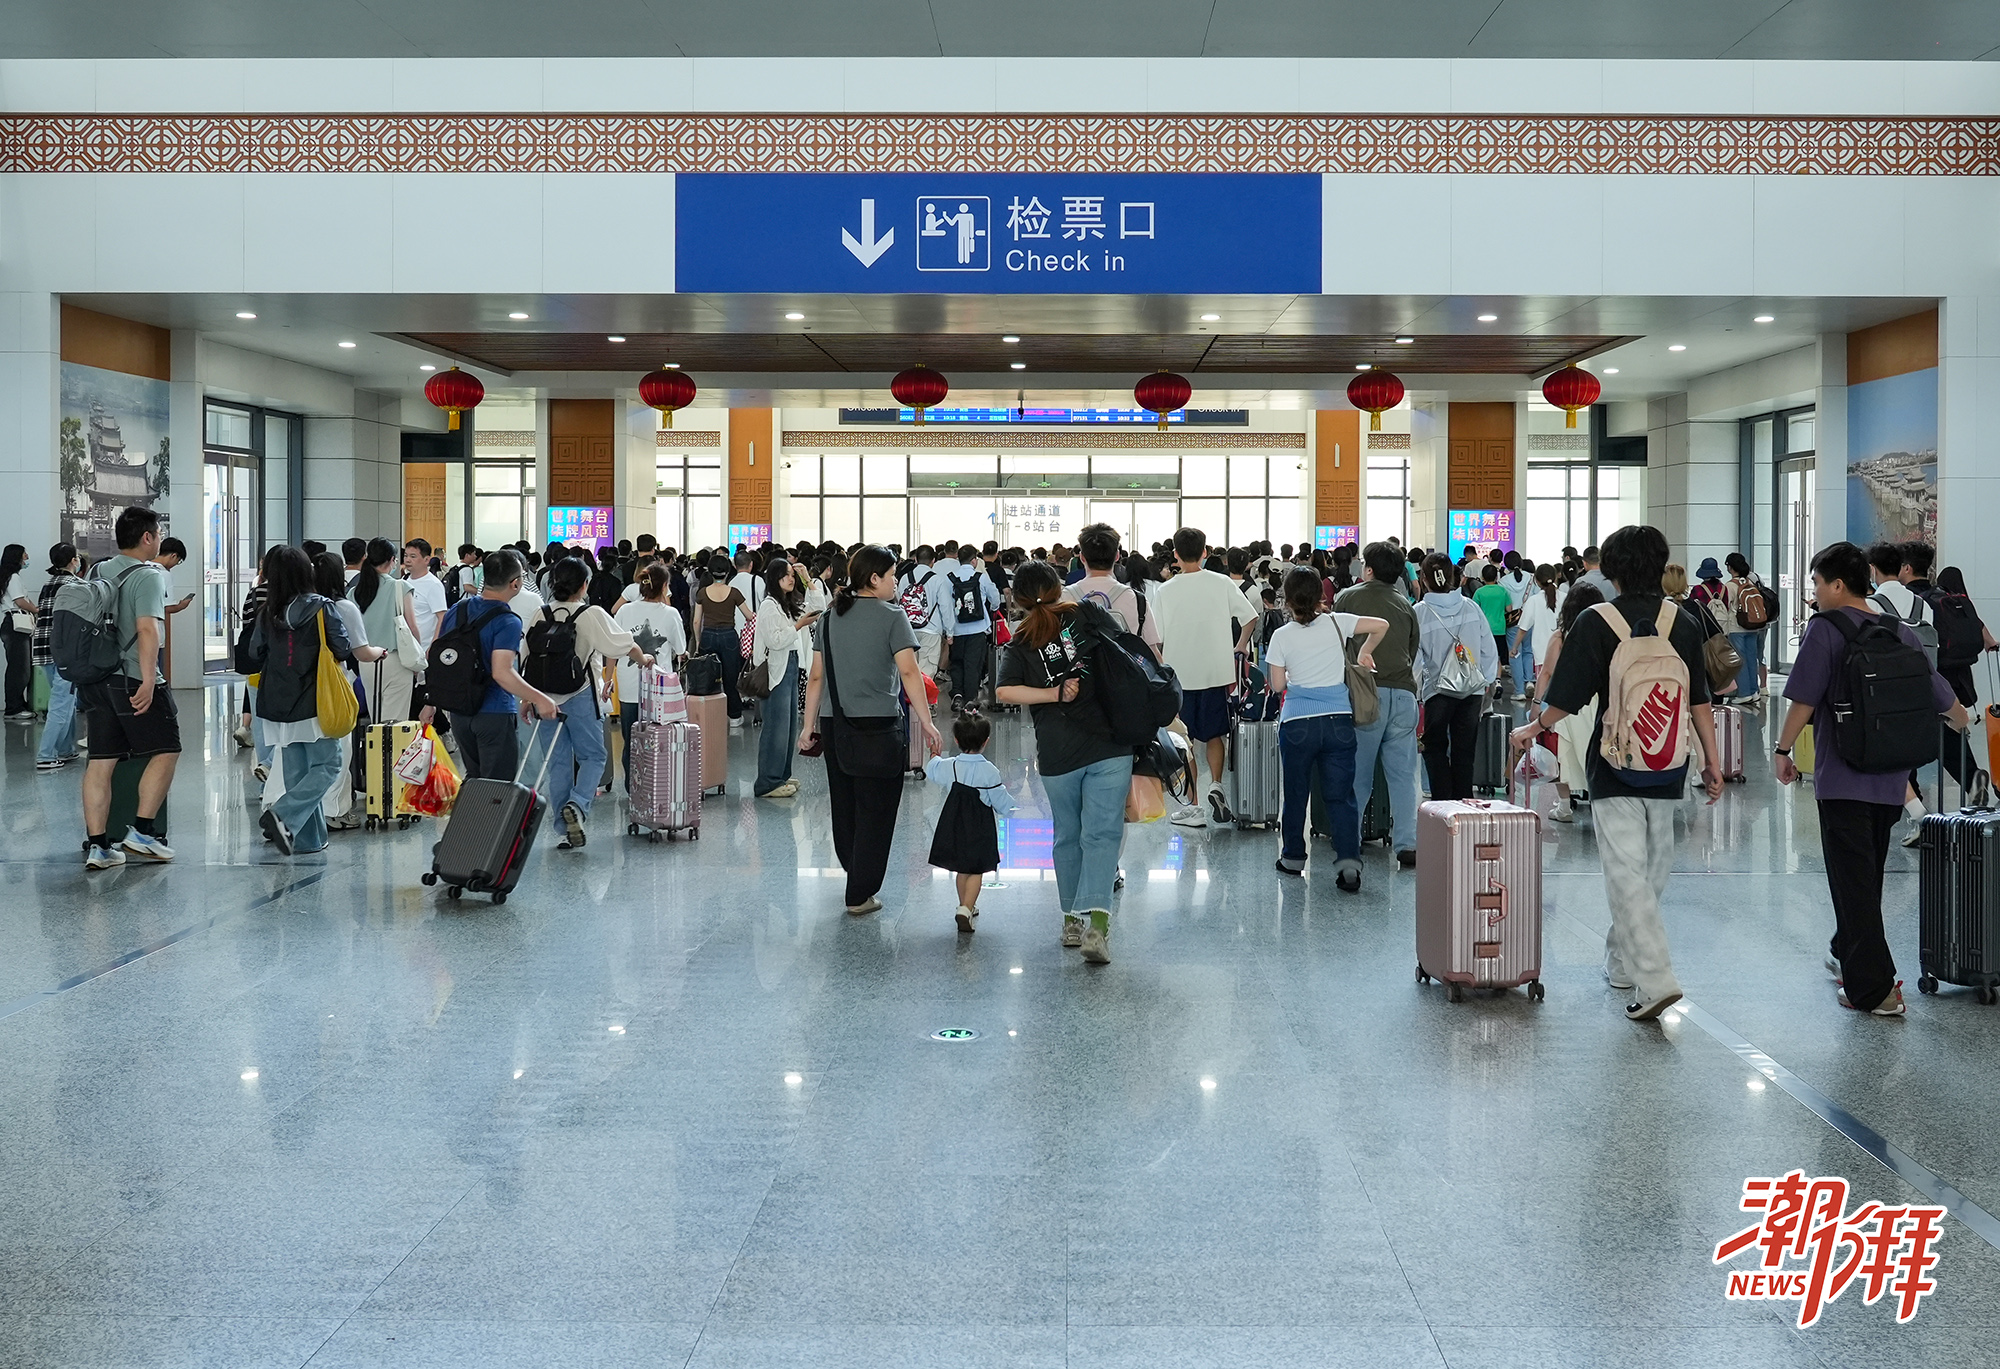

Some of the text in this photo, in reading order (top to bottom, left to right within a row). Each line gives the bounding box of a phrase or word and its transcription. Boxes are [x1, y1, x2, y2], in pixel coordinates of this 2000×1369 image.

[1005, 195, 1156, 241] 检票口
[1005, 249, 1126, 272] Check in
[551, 509, 608, 523] 世界舞台
[1006, 504, 1061, 517] 进站通道
[1452, 512, 1510, 527] 世界舞台
[551, 524, 609, 538] 柒牌风范
[1452, 527, 1511, 541] 柒牌风范
[1632, 682, 1675, 750] NIKE
